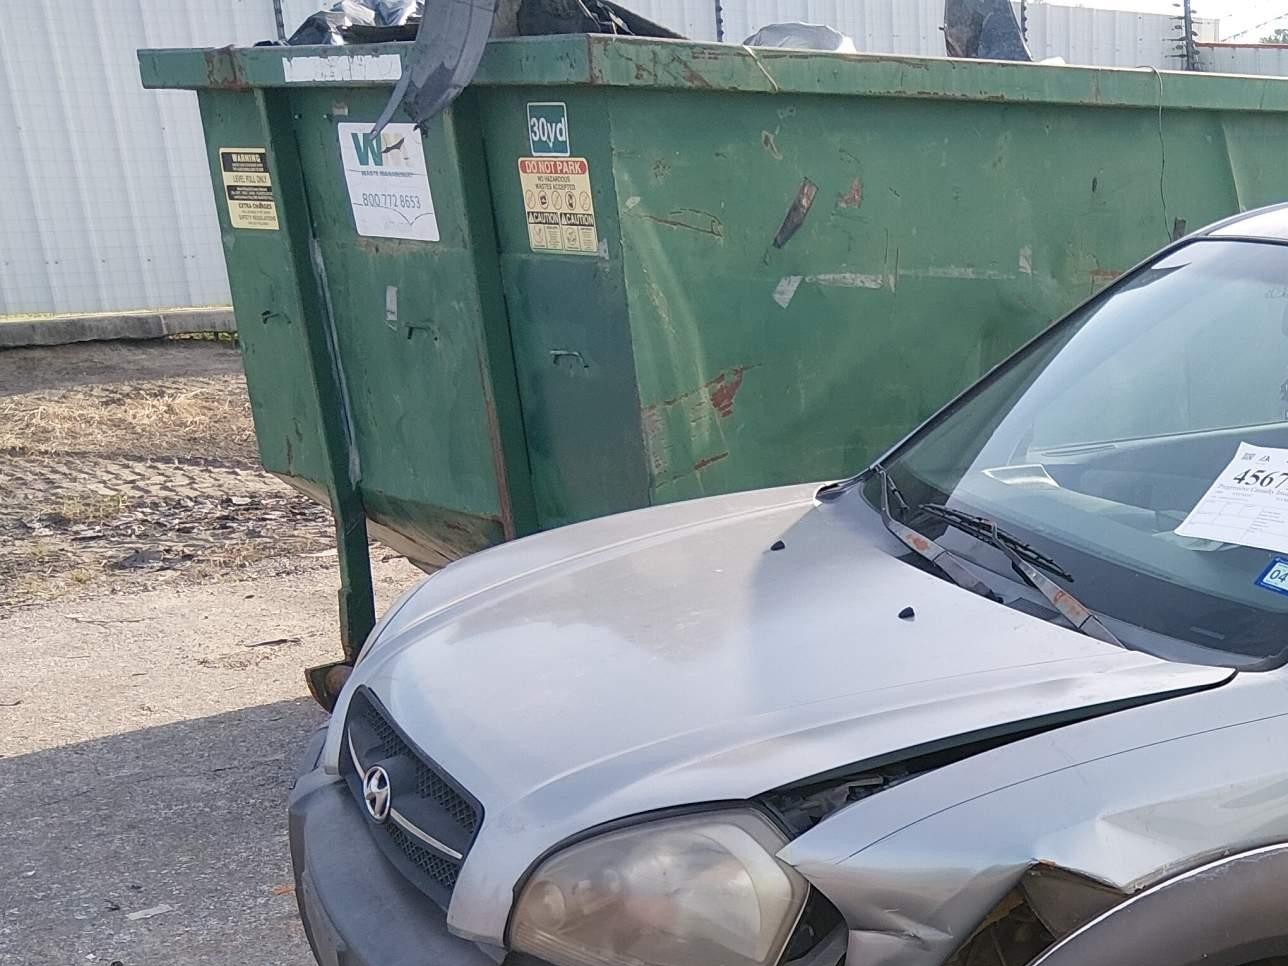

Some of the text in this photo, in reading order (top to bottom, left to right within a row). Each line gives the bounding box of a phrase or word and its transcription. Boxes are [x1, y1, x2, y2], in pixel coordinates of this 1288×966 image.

[530, 117, 566, 148] 30yd
[231, 153, 261, 163] WARNING
[525, 161, 582, 174] DO NOT PARK
[362, 192, 421, 209] 800 772 8653
[534, 212, 559, 224] CAUTION
[566, 213, 594, 226] CAUTION
[1269, 569, 1288, 583] 04
